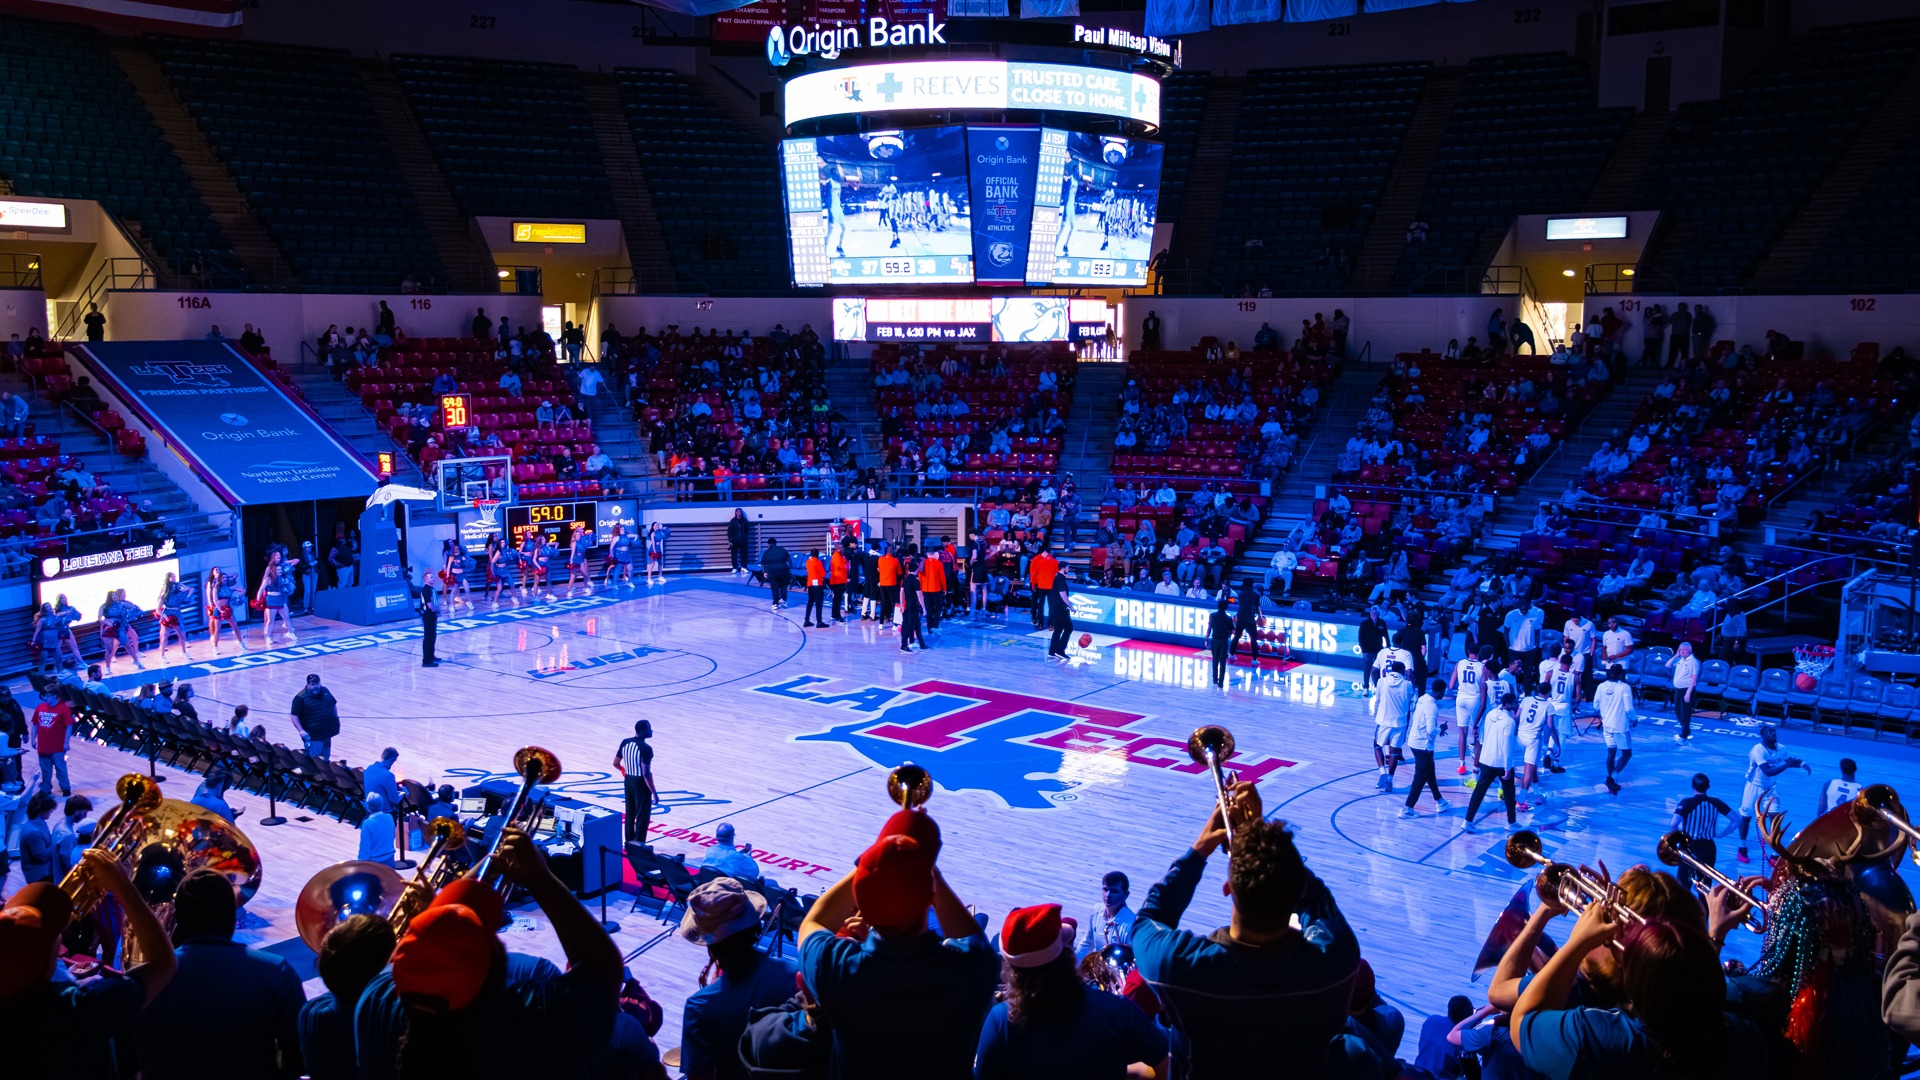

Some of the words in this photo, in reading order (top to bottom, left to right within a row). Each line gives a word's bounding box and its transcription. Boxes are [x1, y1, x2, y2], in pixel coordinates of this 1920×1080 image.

[470, 15, 497, 29] 227
[1513, 9, 1541, 24] 232
[790, 22, 860, 59] Origin
[870, 13, 947, 46] Bank
[1328, 23, 1351, 37] 231
[1074, 24, 1105, 44] Paul
[1108, 28, 1148, 53] Millsap
[1149, 35, 1171, 57] Vision
[913, 76, 1000, 96] REEVES
[1011, 69, 1082, 89] TRUSTED
[1085, 75, 1121, 95] CARE,
[1011, 87, 1063, 105] CLOSE
[1065, 91, 1084, 107] TO
[1043, 132, 1052, 143] LA
[1052, 133, 1066, 145] TECH
[977, 155, 1005, 166] Origin
[1007, 155, 1028, 164] Bank
[985, 176, 1019, 185] OFFICIAL
[985, 186, 1019, 199] BANK
[8, 206, 50, 216] SpeeDee
[861, 260, 878, 274] 37
[885, 262, 911, 274] 59.2
[1078, 261, 1091, 276] 37
[1093, 262, 1111, 276] 59.2
[177, 296, 212, 309] 116A
[410, 298, 431, 310] 116
[1237, 301, 1256, 312] 119
[1849, 298, 1876, 312] 102
[877, 327, 893, 337] FEB
[927, 327, 941, 338] PM
[943, 329, 956, 338] vs
[957, 327, 976, 338] JAX
[138, 388, 199, 396] PREMIER
[200, 386, 269, 395] PARTNERS
[443, 396, 462, 409] 59.0
[446, 407, 466, 426] 30
[201, 429, 255, 442] Origin
[260, 427, 298, 438] Bank
[241, 467, 291, 480] Northern
[292, 464, 341, 475] Louisiana
[257, 473, 300, 485] Medical
[301, 471, 338, 482] Center
[531, 505, 564, 522] 59.0
[570, 521, 586, 530] SHSU
[619, 518, 635, 526] Bank
[513, 526, 522, 534] LA
[62, 550, 125, 572] LOUISIANA
[124, 545, 154, 561] TECH
[1115, 598, 1210, 635] PREMIER
[190, 618, 499, 674] LOUISIANA
[485, 596, 620, 620] TECH
[1462, 669, 1476, 684] 10
[745, 673, 906, 714] LA
[1556, 681, 1566, 694] 0
[1526, 707, 1537, 724] 3
